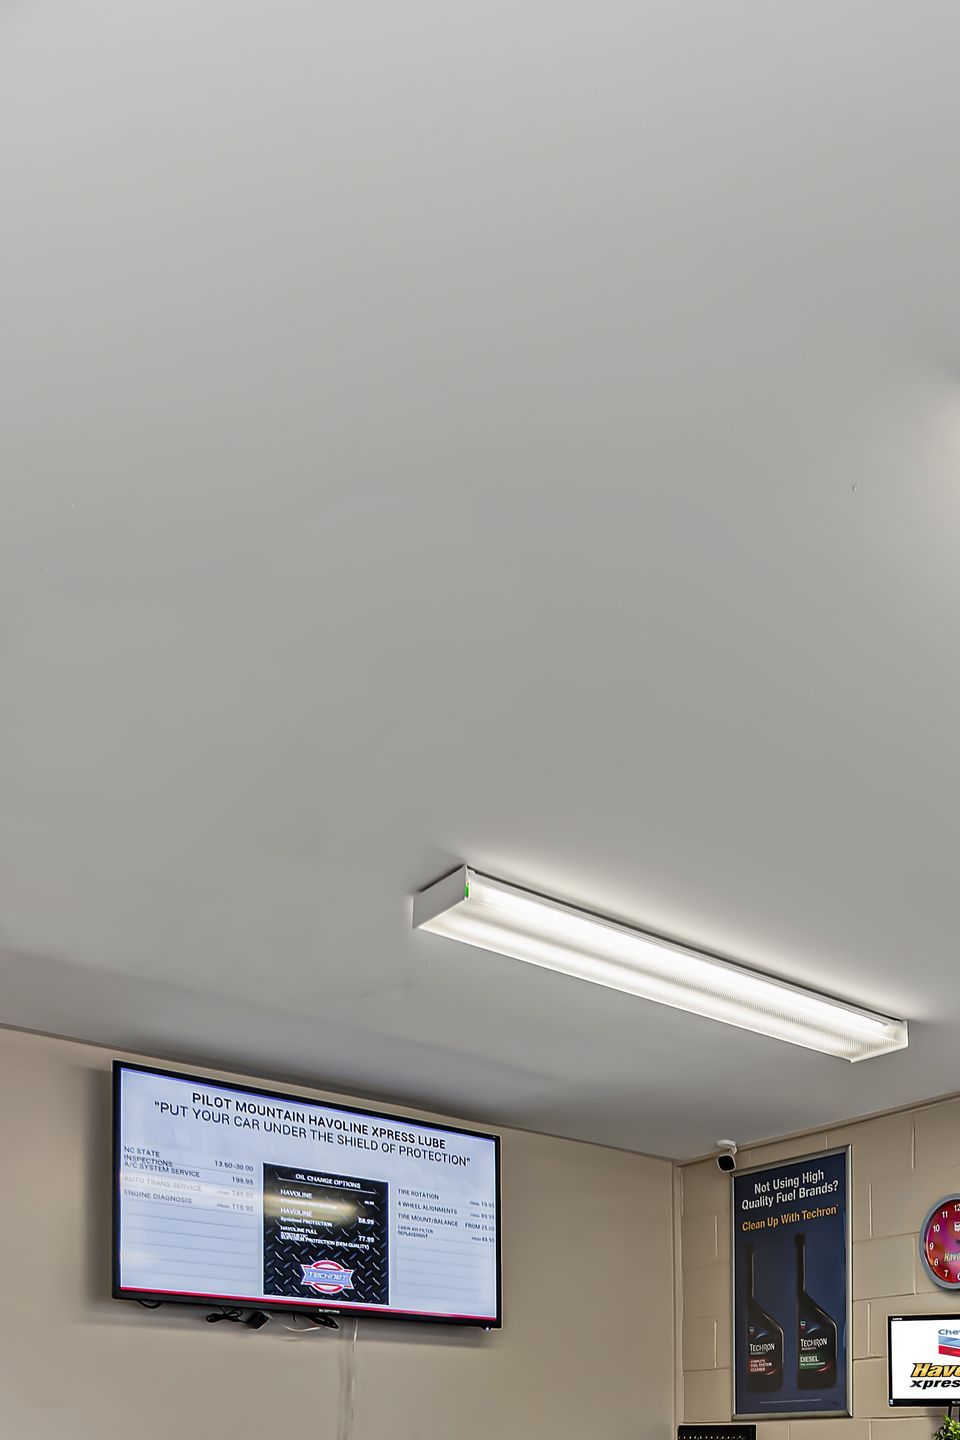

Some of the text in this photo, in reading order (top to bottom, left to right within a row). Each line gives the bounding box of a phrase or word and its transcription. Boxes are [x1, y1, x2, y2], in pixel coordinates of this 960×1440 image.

[192, 1092, 446, 1149] PILOT MOUNTAIN HAVOLINE XPRESS LUBE
[154, 1101, 471, 1167] "PUT YOUR CAR UNDER THE SHIELD OF PROTECTION"
[124, 1145, 160, 1157] NC STATE
[124, 1154, 173, 1167] INSPECTIONS
[139, 1163, 169, 1174] SYSTEM
[171, 1168, 200, 1178] SERVICE
[124, 1176, 144, 1184] AUTO
[147, 1177, 170, 1187] TRANS
[172, 1183, 202, 1192] SERVICE
[307, 1175, 333, 1185] CHANGE
[334, 1179, 360, 1189] OPTIONS
[754, 1169, 824, 1194] Not Using High
[124, 1189, 151, 1199] ENGINE
[153, 1193, 192, 1204] DIAGNOSIS
[280, 1188, 313, 1199] HAVOLINE
[411, 1191, 439, 1200] ROTATION
[742, 1180, 838, 1210] Quality Fuel Brands?
[280, 1207, 312, 1217] HAVOLINE
[403, 1202, 421, 1210] WHEEL
[423, 1204, 457, 1214] ALIGNMENTS
[953, 1203, 960, 1212] 12
[742, 1219, 765, 1231] Clean
[767, 1216, 778, 1228] Up
[781, 1212, 800, 1224] With
[933, 1224, 940, 1232] 10
[929, 1242, 934, 1250] 9
[749, 1343, 775, 1352] TECHRON
[800, 1338, 827, 1347] TECHRON
[800, 1355, 819, 1363] DIESEL
